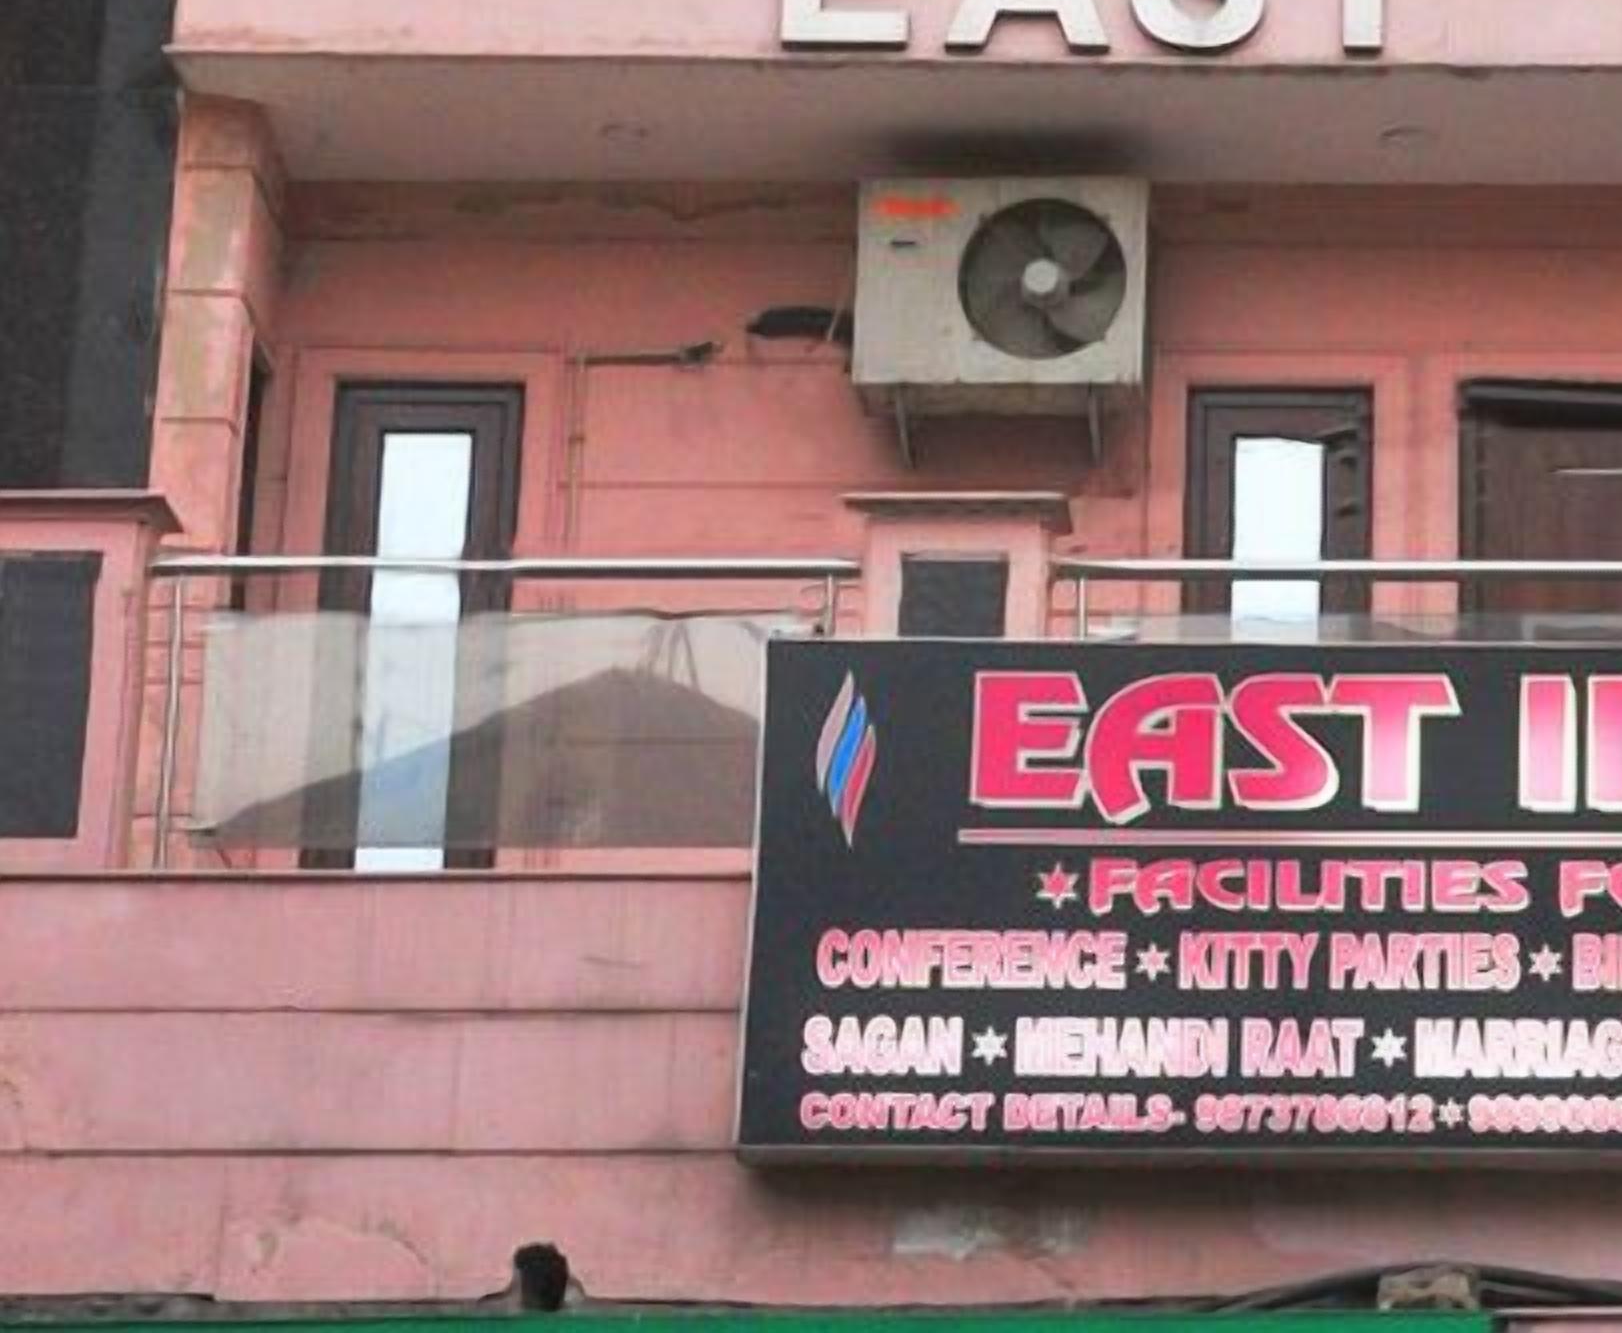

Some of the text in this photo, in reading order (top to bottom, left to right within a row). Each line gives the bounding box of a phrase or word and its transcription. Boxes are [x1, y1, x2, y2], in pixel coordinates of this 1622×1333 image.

[969, 671, 1462, 823] EAST
[1088, 857, 1530, 916] FACILITIES
[816, 929, 1127, 989] CONFERENCE
[1178, 931, 1319, 990] KITTY
[1329, 932, 1521, 992] PARTIES
[801, 1014, 963, 1076] SAGAN
[1014, 1017, 1229, 1078] MEHANDI
[1241, 1018, 1364, 1078] RAAT
[800, 1091, 995, 1131] CONTACT
